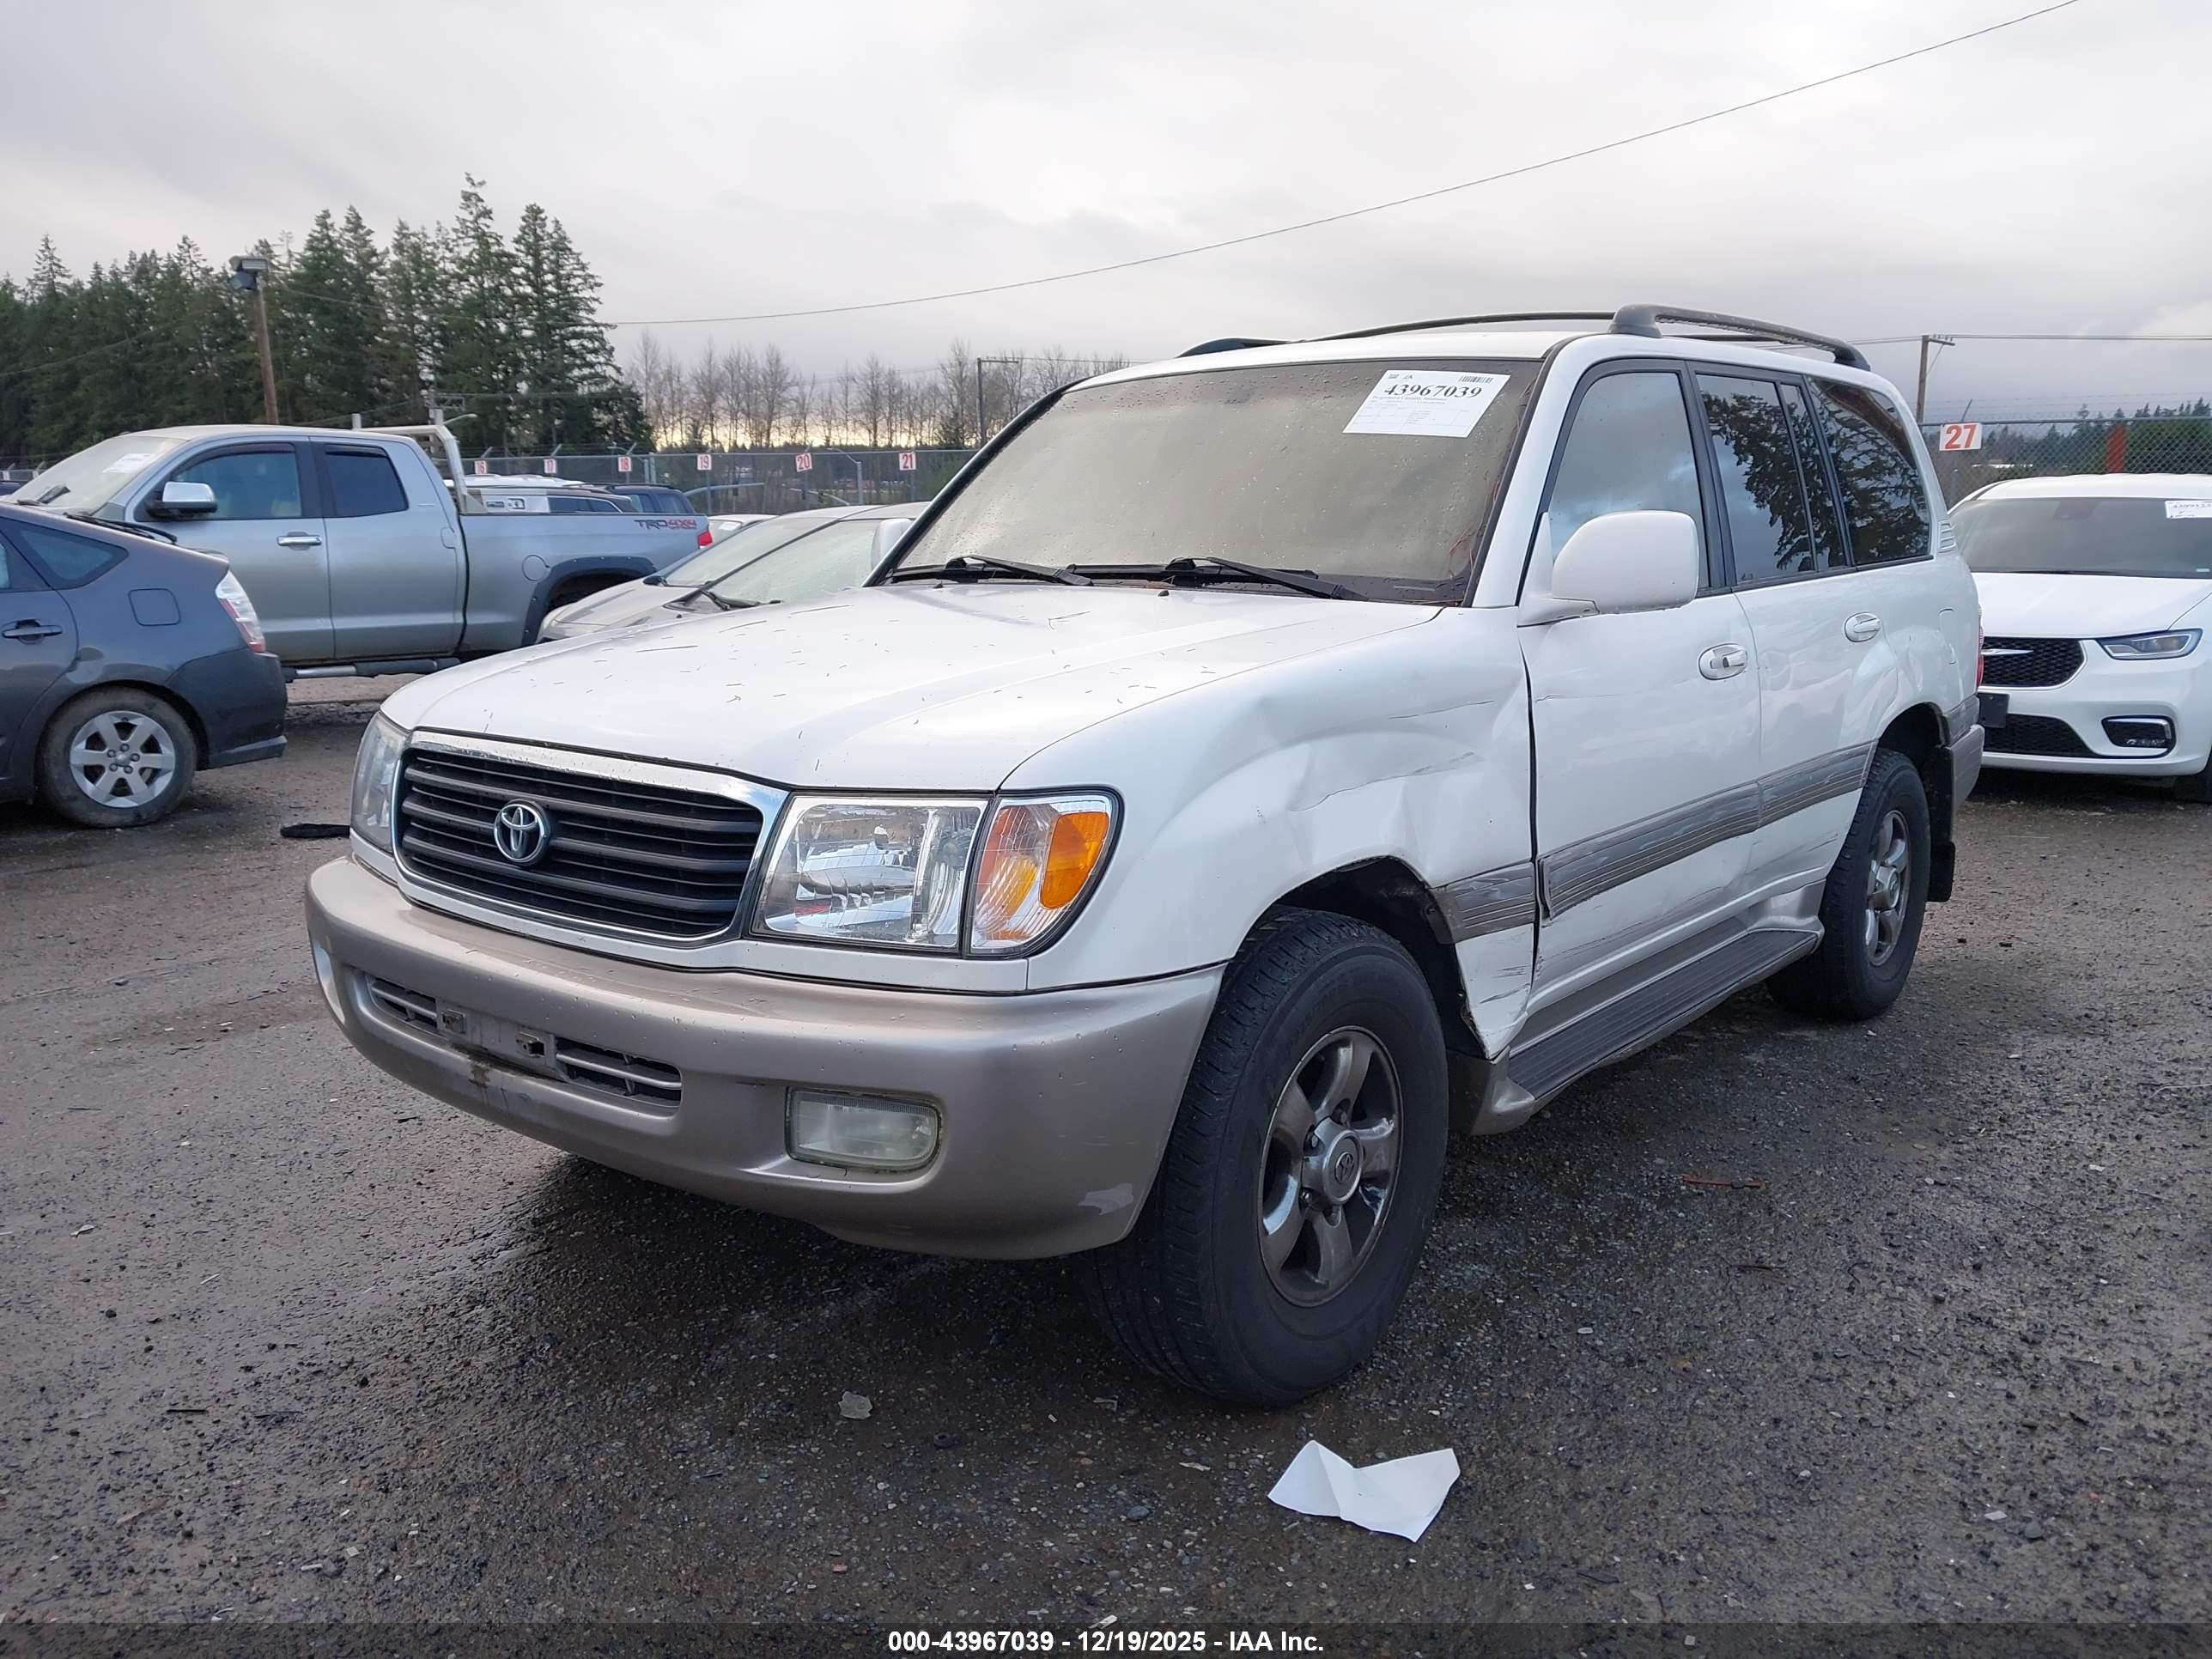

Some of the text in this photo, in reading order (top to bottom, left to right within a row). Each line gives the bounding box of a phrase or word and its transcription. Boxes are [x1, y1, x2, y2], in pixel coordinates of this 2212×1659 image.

[1383, 383, 1483, 398] 43967039
[1944, 424, 1977, 449] 27
[620, 457, 629, 471] 18
[700, 455, 709, 469] 19
[797, 454, 810, 470] 20
[902, 453, 913, 469] 21
